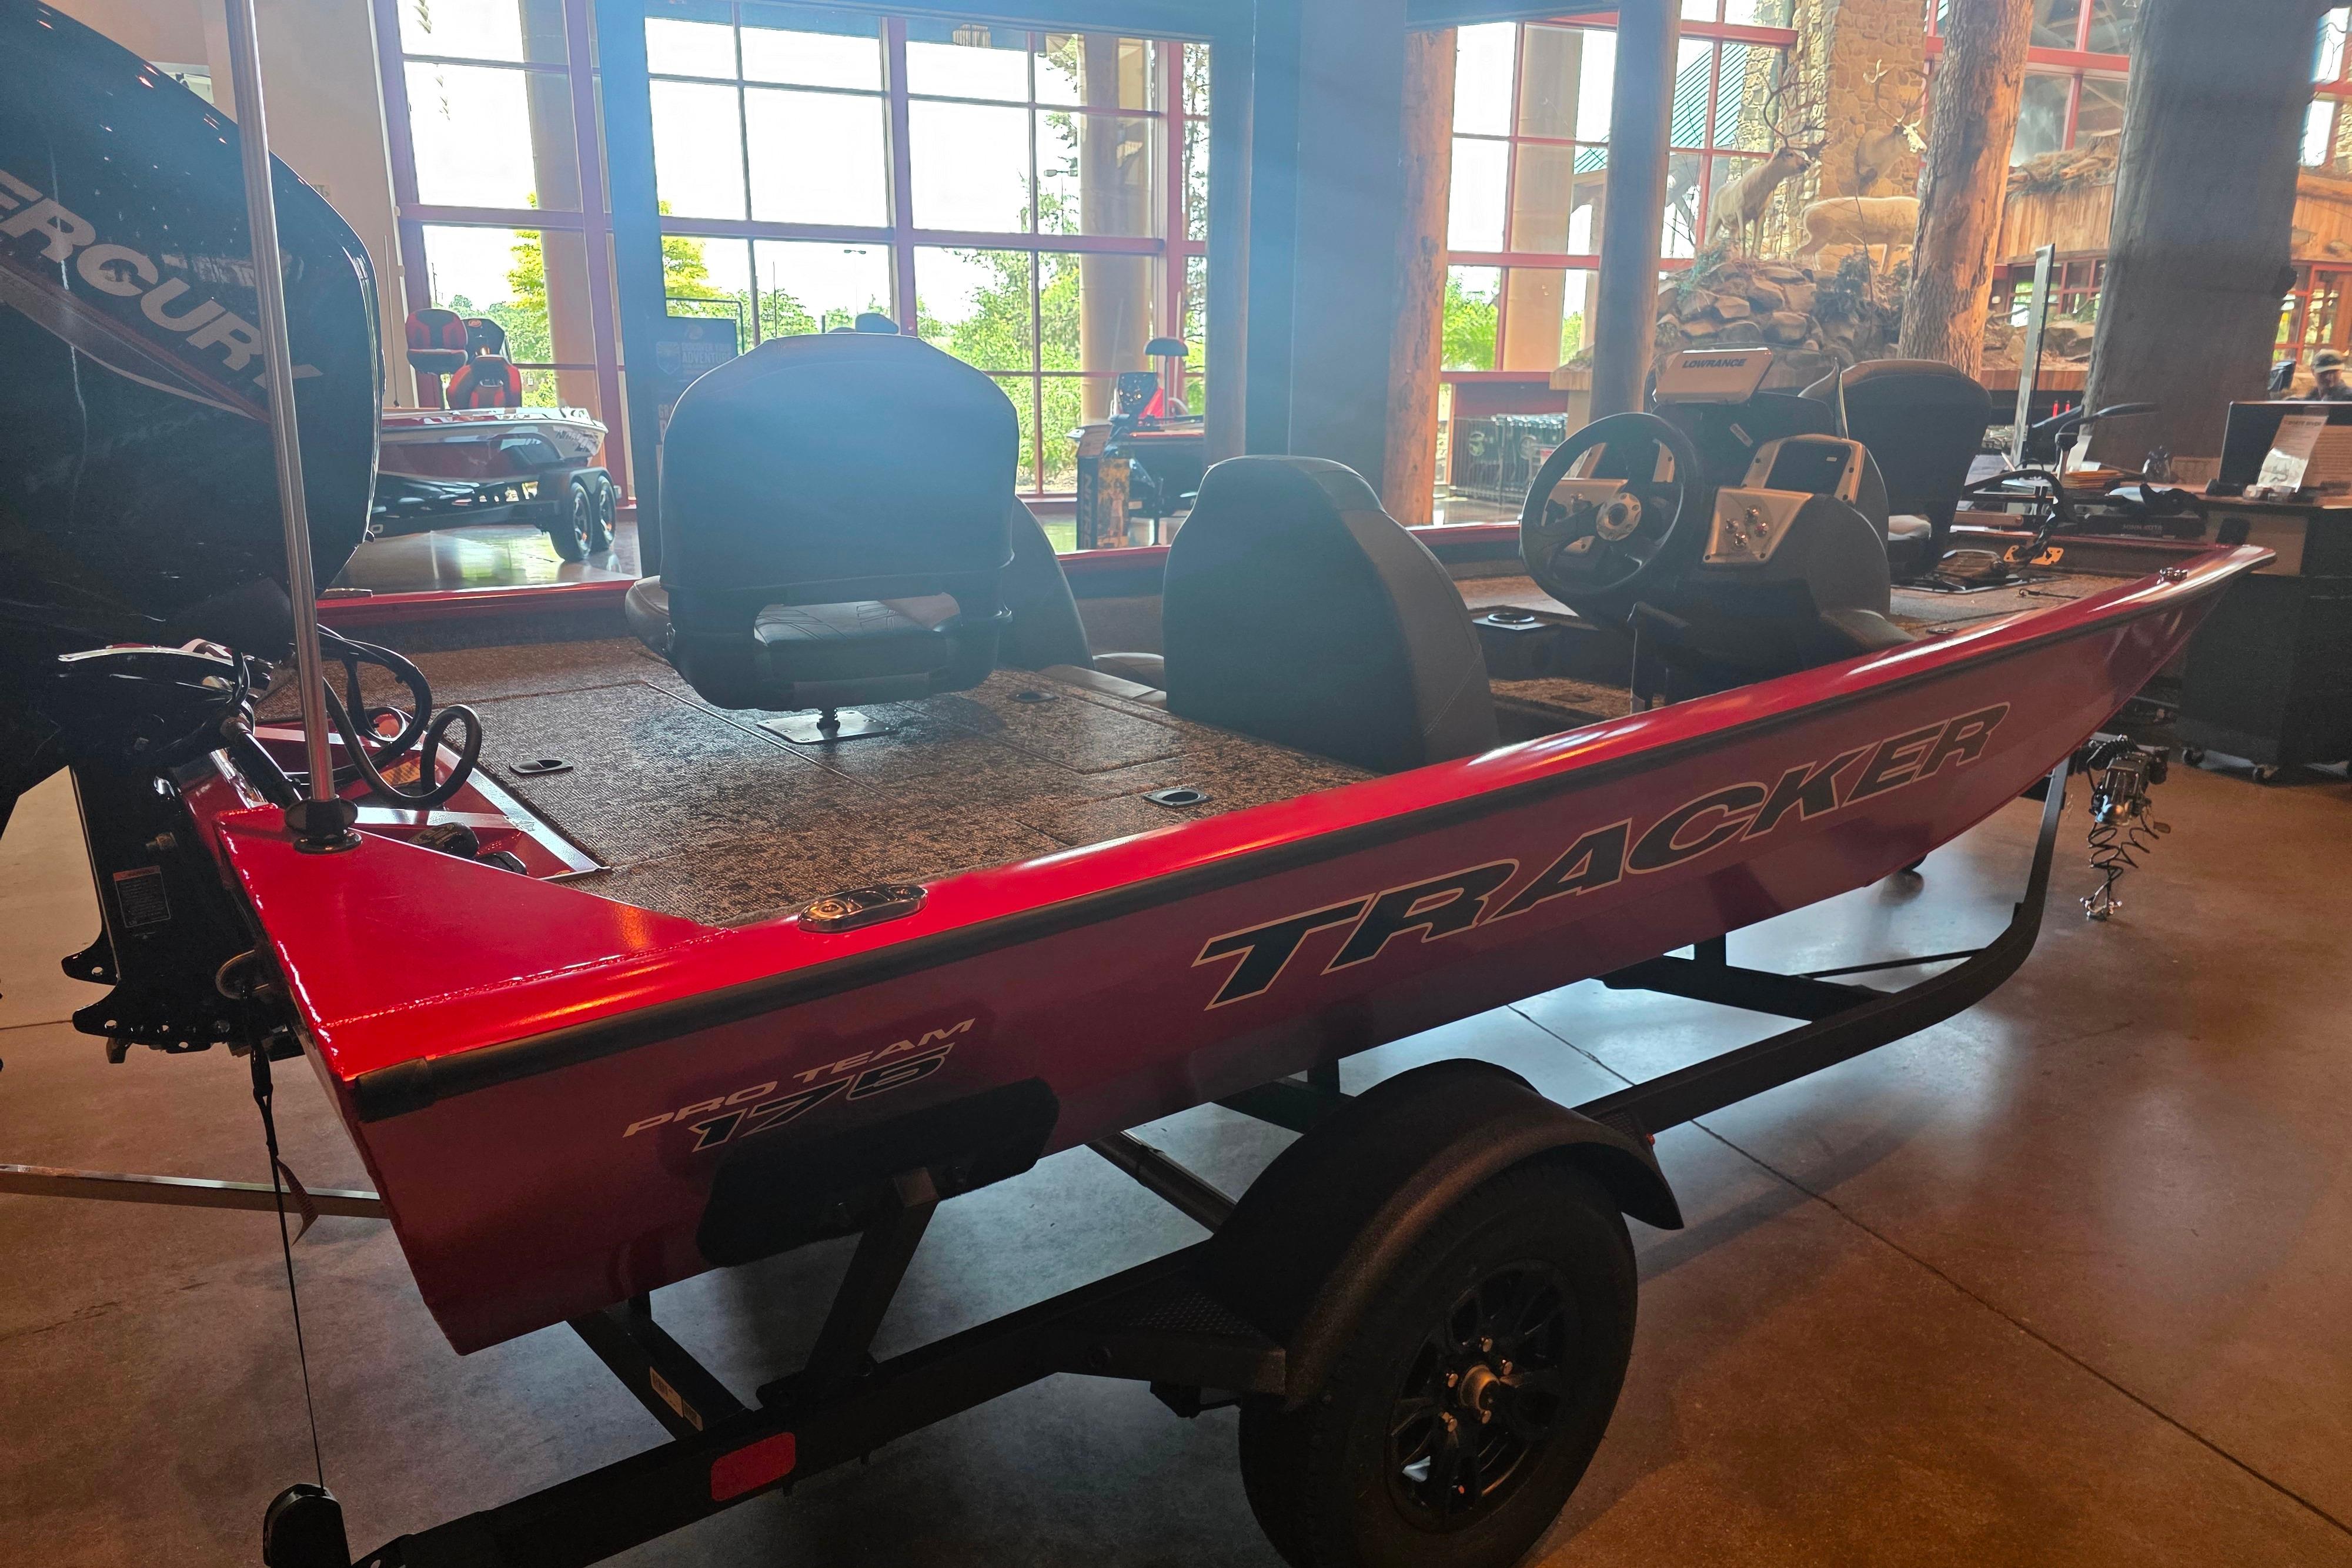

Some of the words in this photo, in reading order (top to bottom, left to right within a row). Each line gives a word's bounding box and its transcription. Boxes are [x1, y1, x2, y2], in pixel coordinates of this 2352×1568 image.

[0, 169, 323, 389] ERCUR
[1682, 358, 1748, 368] LOWRANCE
[1191, 702, 2010, 1011] TRACKER
[622, 1081, 778, 1138] PRO
[793, 1018, 976, 1083] TEAM
[687, 1042, 956, 1152] 175
